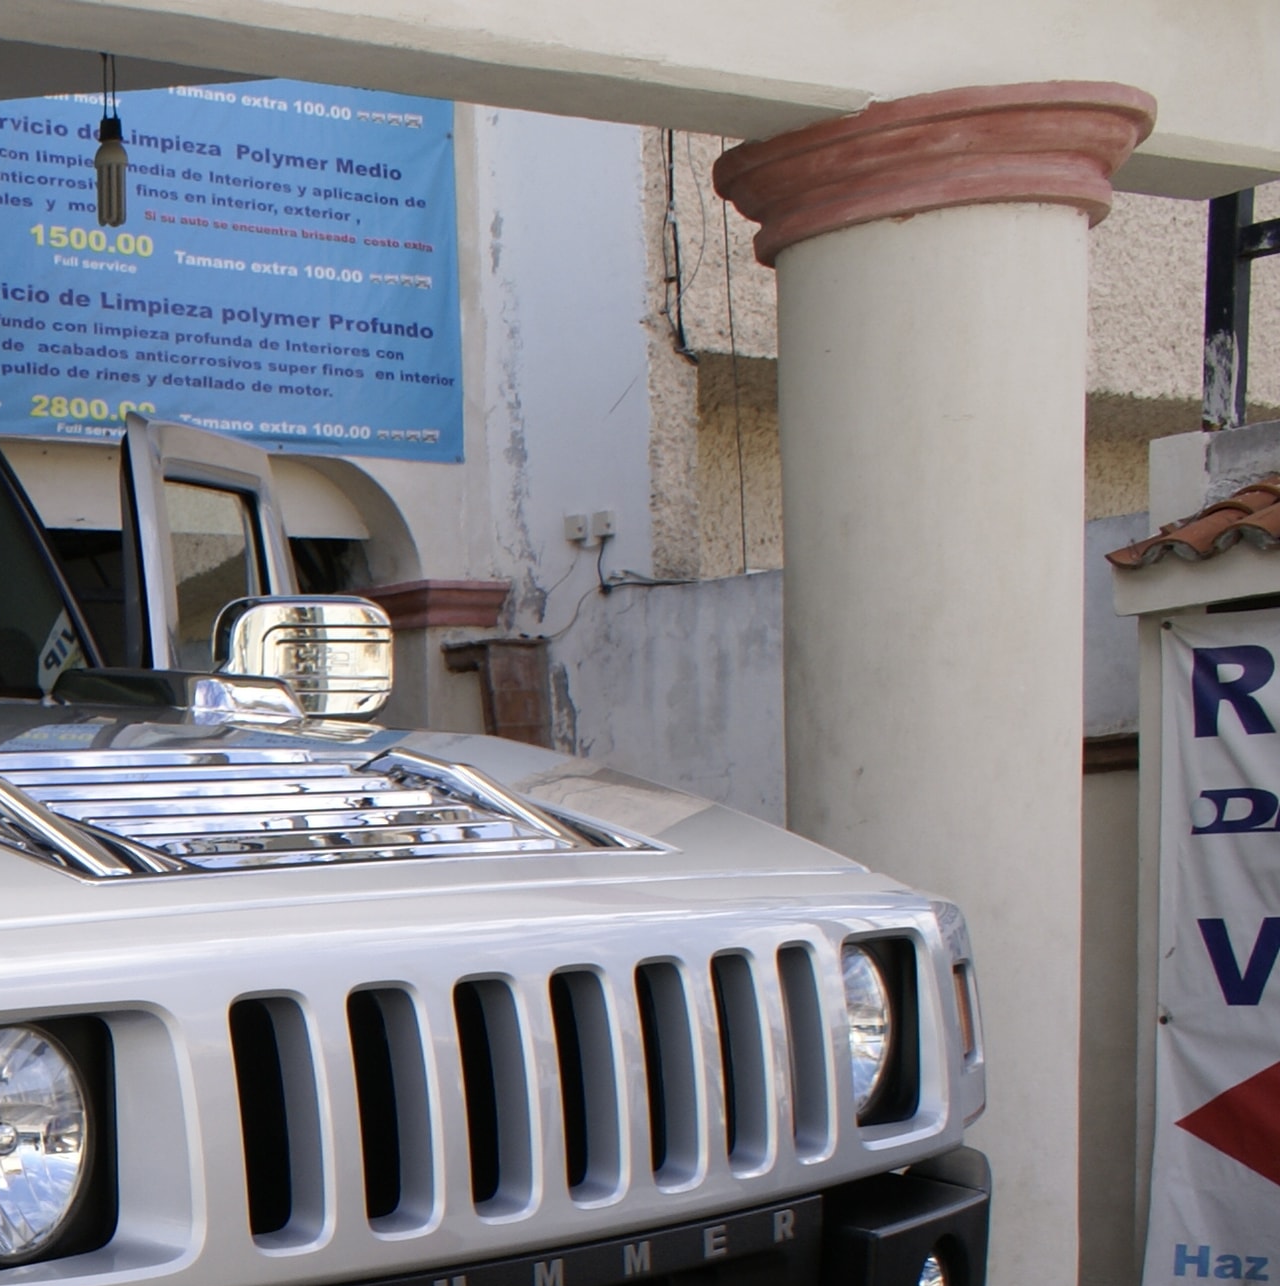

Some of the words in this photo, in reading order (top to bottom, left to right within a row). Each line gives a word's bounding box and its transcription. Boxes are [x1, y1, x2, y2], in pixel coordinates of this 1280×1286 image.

[241, 95, 288, 112] extra
[293, 100, 352, 120] 100.00
[121, 130, 222, 157] impieza
[236, 144, 328, 171] Polymer
[336, 157, 402, 181] Medio
[36, 150, 96, 170] limpie
[128, 163, 176, 179] media
[182, 167, 202, 182] de
[209, 171, 292, 194] Interiores
[297, 184, 308, 197] y
[312, 185, 399, 207] aplicacion
[405, 195, 426, 209] de
[136, 184, 179, 201] finos
[184, 192, 207, 205] en
[45, 199, 56, 212] y
[30, 223, 154, 258] 1500.00
[144, 211, 157, 221] Si
[160, 214, 176, 224] su
[180, 215, 210, 228] auto
[213, 220, 228, 230] se
[232, 221, 297, 238] encuentra
[301, 229, 356, 244] briseado
[363, 236, 400, 249] costo
[404, 241, 433, 253] extra
[54, 254, 78, 267] Full
[82, 258, 137, 273] service
[175, 250, 246, 271] Tamano
[251, 261, 298, 278] extra
[304, 265, 363, 283] 100.00
[58, 288, 90, 307] de
[100, 291, 213, 319] Limpieza
[222, 307, 320, 329] polymer
[329, 313, 434, 340] Profundo
[52, 321, 87, 333] con
[93, 322, 169, 341] limpieza
[175, 331, 252, 348] profunda
[259, 338, 280, 351] de
[286, 340, 370, 358] Interiores
[376, 349, 405, 361] con
[1, 362, 60, 378] pulido
[67, 366, 90, 379] de
[96, 369, 140, 384] rines
[147, 376, 157, 387] y
[162, 373, 246, 391] detallado
[251, 379, 273, 393] de
[278, 382, 333, 398] motor.
[2, 338, 25, 352] de
[37, 341, 129, 360] acabados
[135, 349, 262, 371] anticorrosivos
[268, 363, 317, 377] super
[322, 364, 364, 379] finos
[375, 369, 395, 381] en
[400, 370, 454, 387] interior
[57, 422, 79, 434] Full
[83, 424, 128, 438] servi
[260, 421, 307, 436] extra
[312, 423, 371, 440] 100.00
[1192, 645, 1276, 737] R
[1174, 1244, 1269, 1281] Haz
